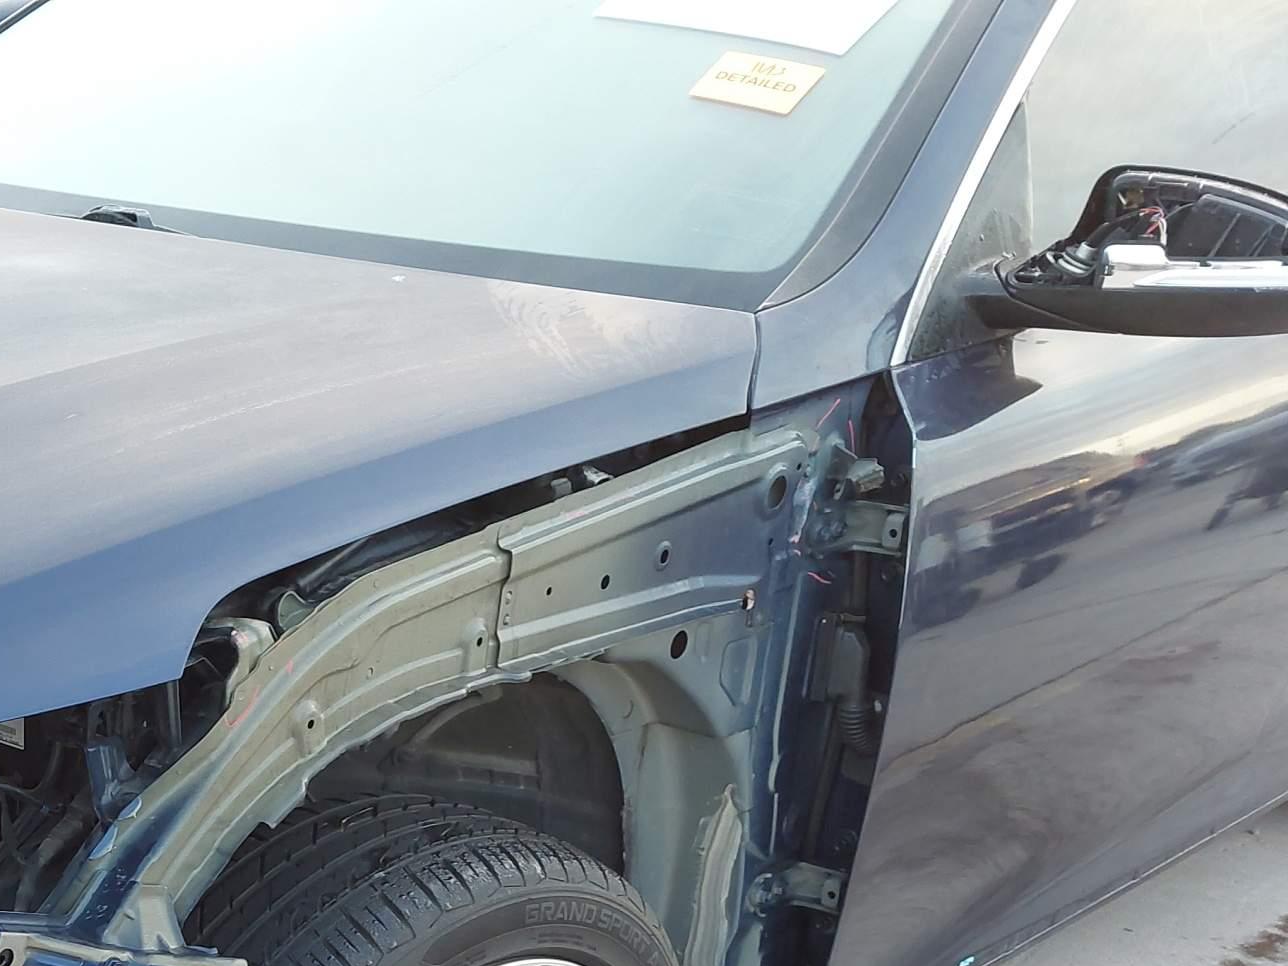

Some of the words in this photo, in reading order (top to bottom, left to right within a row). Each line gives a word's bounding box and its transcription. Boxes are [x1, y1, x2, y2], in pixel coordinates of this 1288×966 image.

[714, 70, 797, 93] DETAILED
[524, 900, 598, 925] GRAND
[596, 910, 651, 956] SPORT
